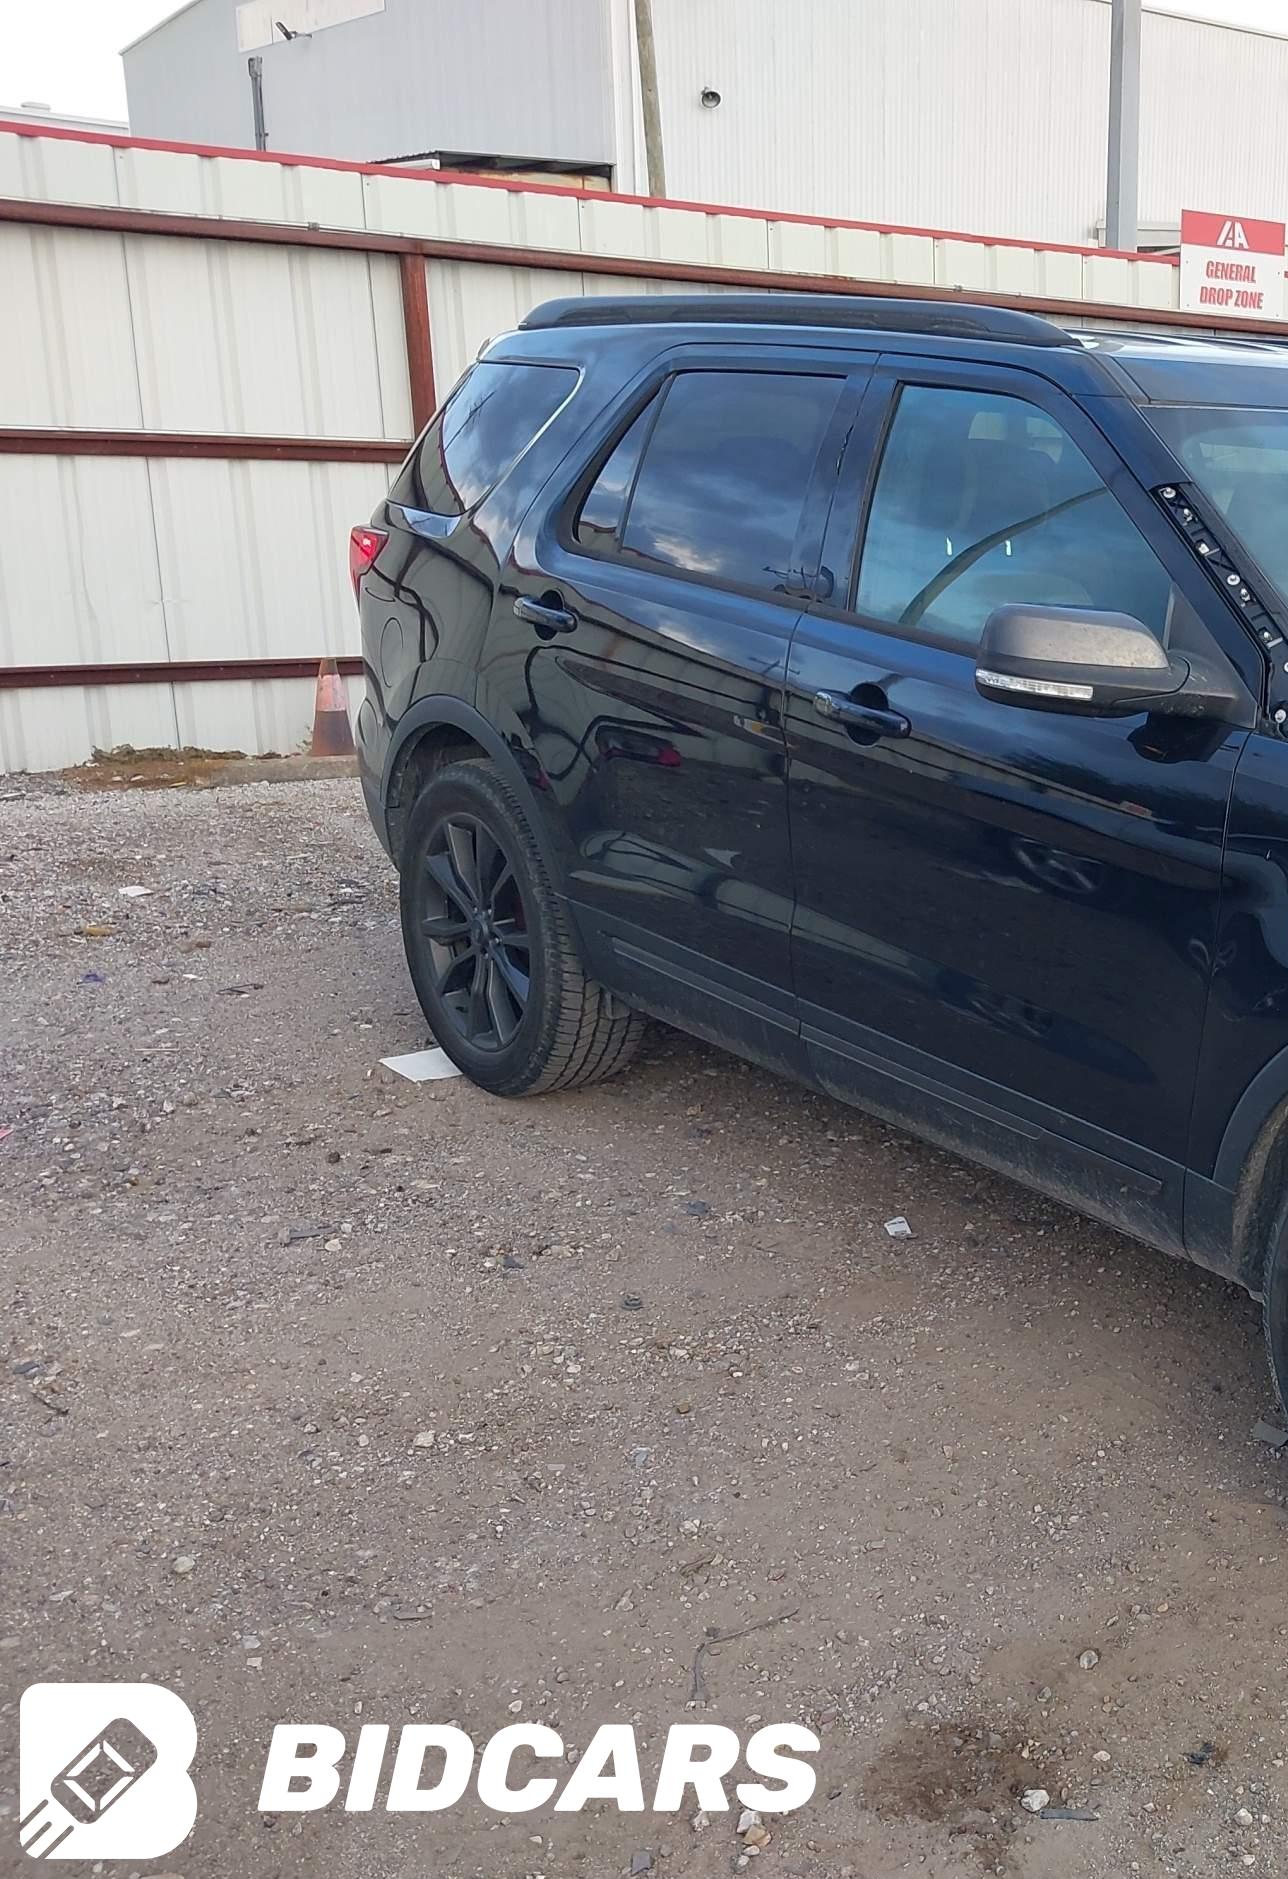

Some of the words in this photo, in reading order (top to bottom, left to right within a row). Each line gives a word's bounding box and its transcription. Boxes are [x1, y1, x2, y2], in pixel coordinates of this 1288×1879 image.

[1205, 260, 1256, 283] GENERAL
[1200, 286, 1233, 306] DROP
[1233, 290, 1264, 310] ZONE
